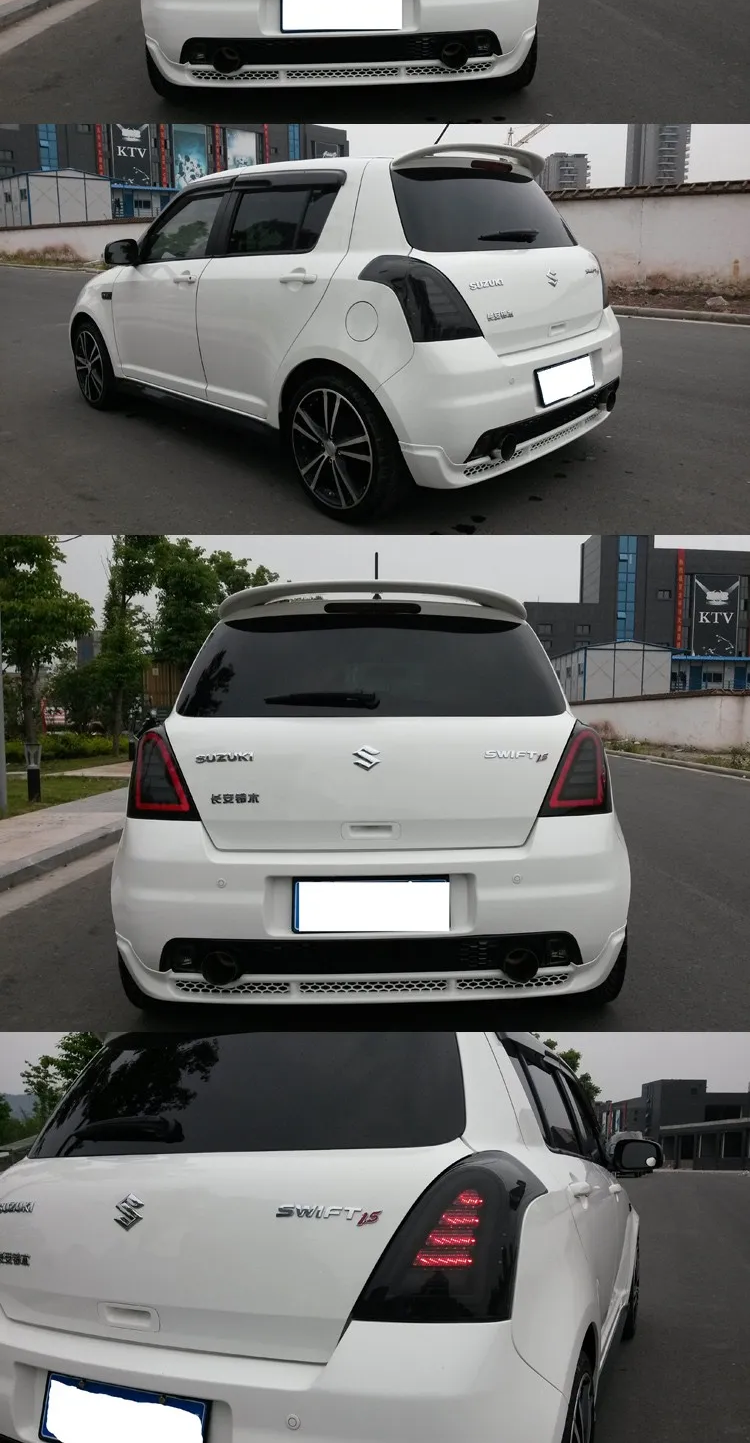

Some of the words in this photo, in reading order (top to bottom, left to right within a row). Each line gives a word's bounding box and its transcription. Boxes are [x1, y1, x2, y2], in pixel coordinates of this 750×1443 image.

[117, 146, 147, 158] KTV
[469, 279, 504, 290] SUZUKI
[699, 611, 734, 624] KTV
[195, 752, 254, 764] SUZUKI
[484, 750, 538, 760] SWIFT
[211, 793, 260, 804] 长安铃木
[275, 1204, 362, 1221] SWIFT
